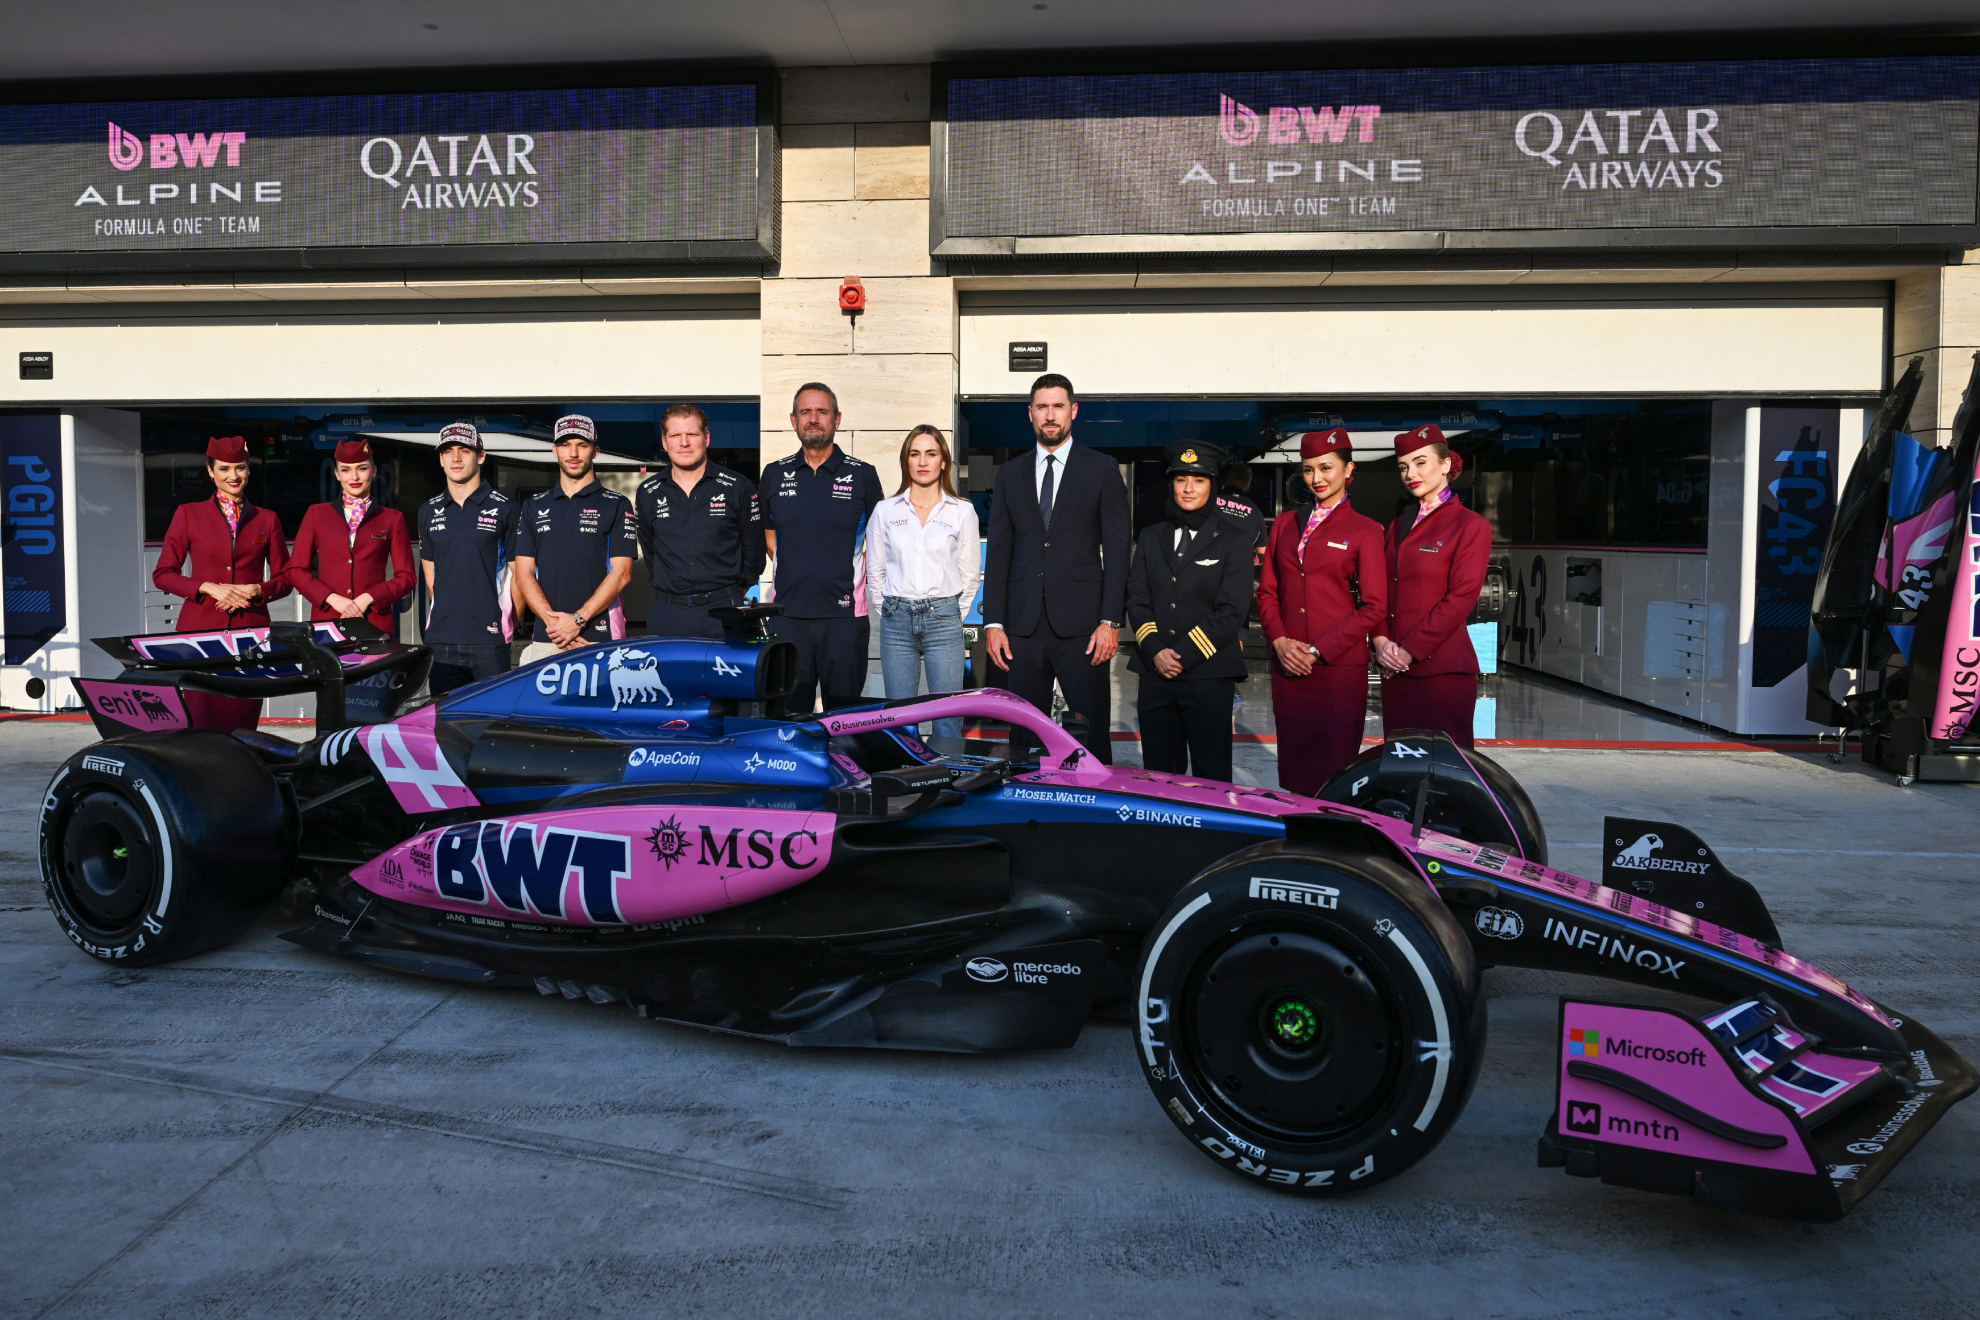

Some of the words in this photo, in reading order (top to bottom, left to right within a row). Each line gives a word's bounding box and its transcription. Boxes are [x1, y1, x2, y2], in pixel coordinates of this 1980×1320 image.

[1267, 105, 1381, 144] BWT
[1514, 108, 1722, 167] QATAR
[150, 131, 246, 169] BWT
[360, 133, 538, 189] QATAR
[1179, 158, 1422, 185] ALPINE
[1561, 159, 1723, 189] AIRWAYS
[74, 181, 282, 207] ALPINE
[401, 181, 539, 209] AIRWAYS
[1202, 198, 1285, 217] FORMULA
[1348, 197, 1396, 215] TEAM
[95, 218, 165, 236] FORMULA
[219, 216, 260, 234] TEAM
[342, 416, 360, 426] eni
[1309, 415, 1328, 426] eni
[1440, 413, 1460, 424] eni
[1227, 500, 1252, 515] BWT
[1766, 450, 1827, 576] FC43
[1898, 565, 1934, 610] 43
[536, 651, 606, 698] eni
[1949, 647, 1980, 715] MSC
[99, 690, 138, 717] eni
[842, 713, 896, 730] businessolver
[82, 755, 126, 777] PIRELLI
[646, 751, 701, 767] ApeCoin
[767, 759, 797, 772] MODO
[1135, 809, 1203, 829] BINANCE
[410, 847, 432, 862] CHANGE
[697, 824, 818, 870] MSC
[380, 857, 405, 881] ADA
[435, 818, 632, 925] BWT
[1614, 853, 1711, 875] OAKBERRY
[380, 876, 405, 890] COSMETICS
[1249, 876, 1341, 910] PIRELLI
[471, 916, 486, 926] TRAK
[486, 918, 506, 928] RACER
[67, 929, 128, 959] ZERO
[1542, 917, 1687, 980] INFINOX
[1013, 961, 1082, 975] mercado
[1014, 972, 1048, 984] libre
[1605, 1036, 1707, 1068] Microsoft
[1607, 1113, 1680, 1142] mntn
[1200, 1136, 1336, 1188] ZERO
